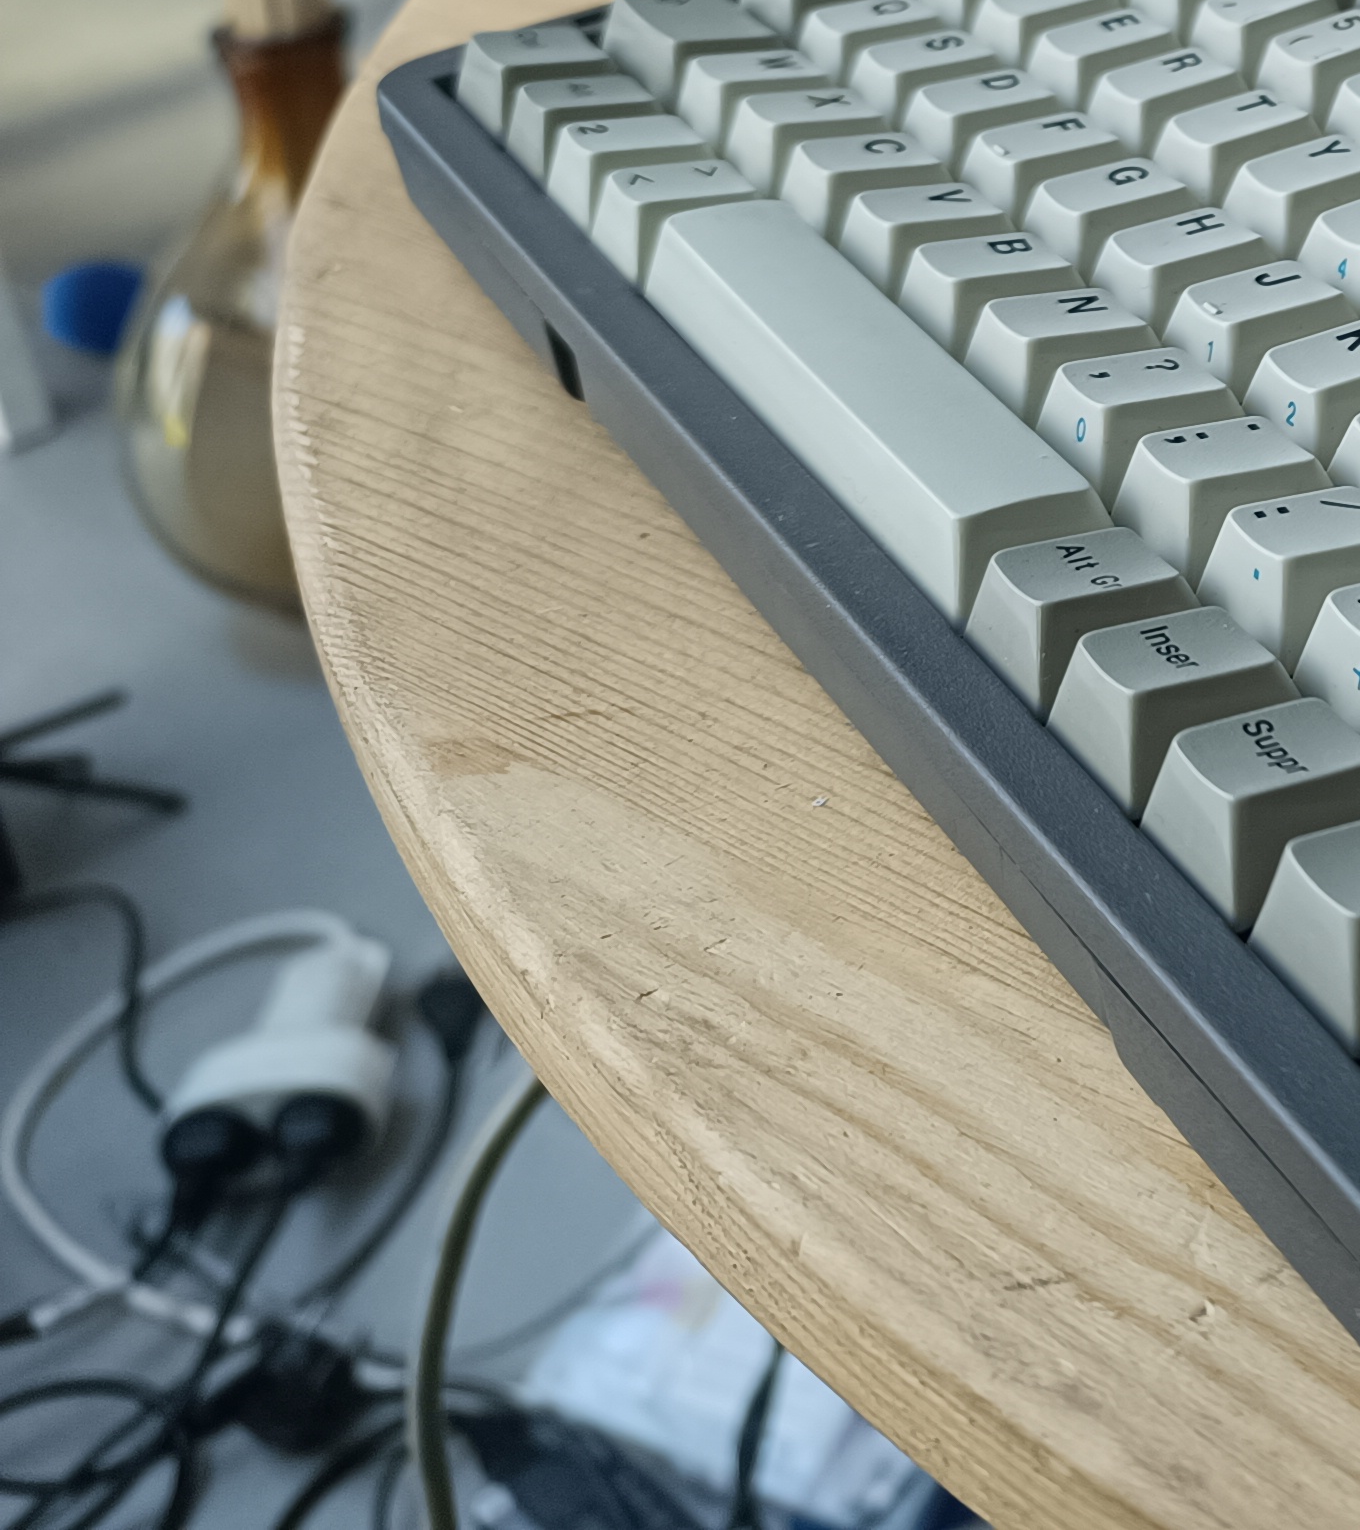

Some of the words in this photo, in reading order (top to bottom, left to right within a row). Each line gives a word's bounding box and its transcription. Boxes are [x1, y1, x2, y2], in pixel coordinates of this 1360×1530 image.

[1100, 14, 1142, 32] E
[925, 35, 965, 51] S
[1161, 52, 1203, 72] R
[981, 74, 1021, 90] D
[806, 93, 852, 109] X
[1235, 94, 1277, 112] T
[1041, 117, 1087, 133] F
[864, 138, 907, 155] C
[1308, 140, 1352, 159] Y
[1107, 166, 1150, 186] G
[928, 188, 973, 203] V
[1177, 213, 1225, 236] H
[987, 237, 1034, 255] B
[1254, 272, 1302, 288] J
[1057, 294, 1109, 315] N
[1286, 401, 1297, 427] 2
[1055, 543, 1101, 572] Alt
[1090, 574, 1123, 589] Gr
[1139, 625, 1199, 669] Inser
[1242, 719, 1310, 775] Suppr
